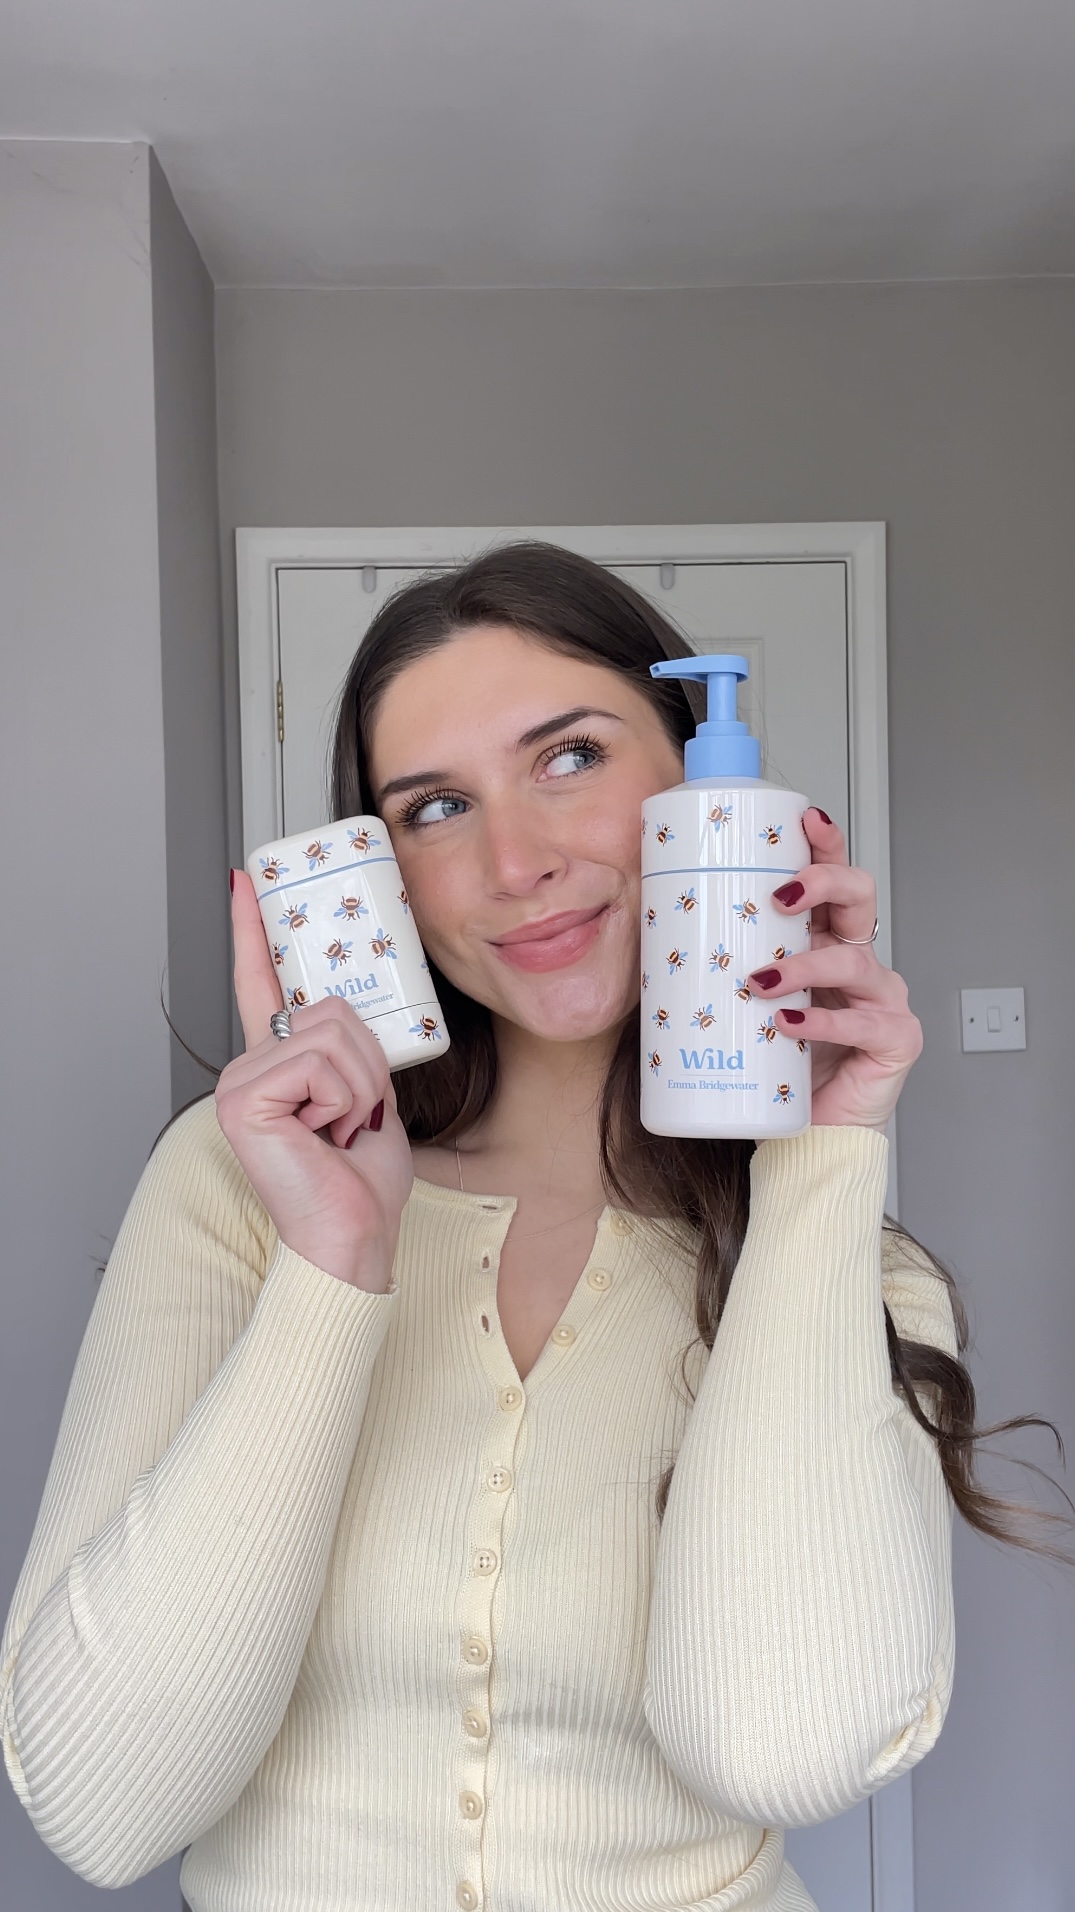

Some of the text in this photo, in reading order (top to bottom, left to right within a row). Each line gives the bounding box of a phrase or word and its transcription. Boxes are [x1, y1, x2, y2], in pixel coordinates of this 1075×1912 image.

[324, 973, 379, 998] Wild
[352, 993, 394, 1010] ridgewater
[679, 1048, 745, 1070] Wild
[667, 1080, 759, 1092] Emma Bridgewater
